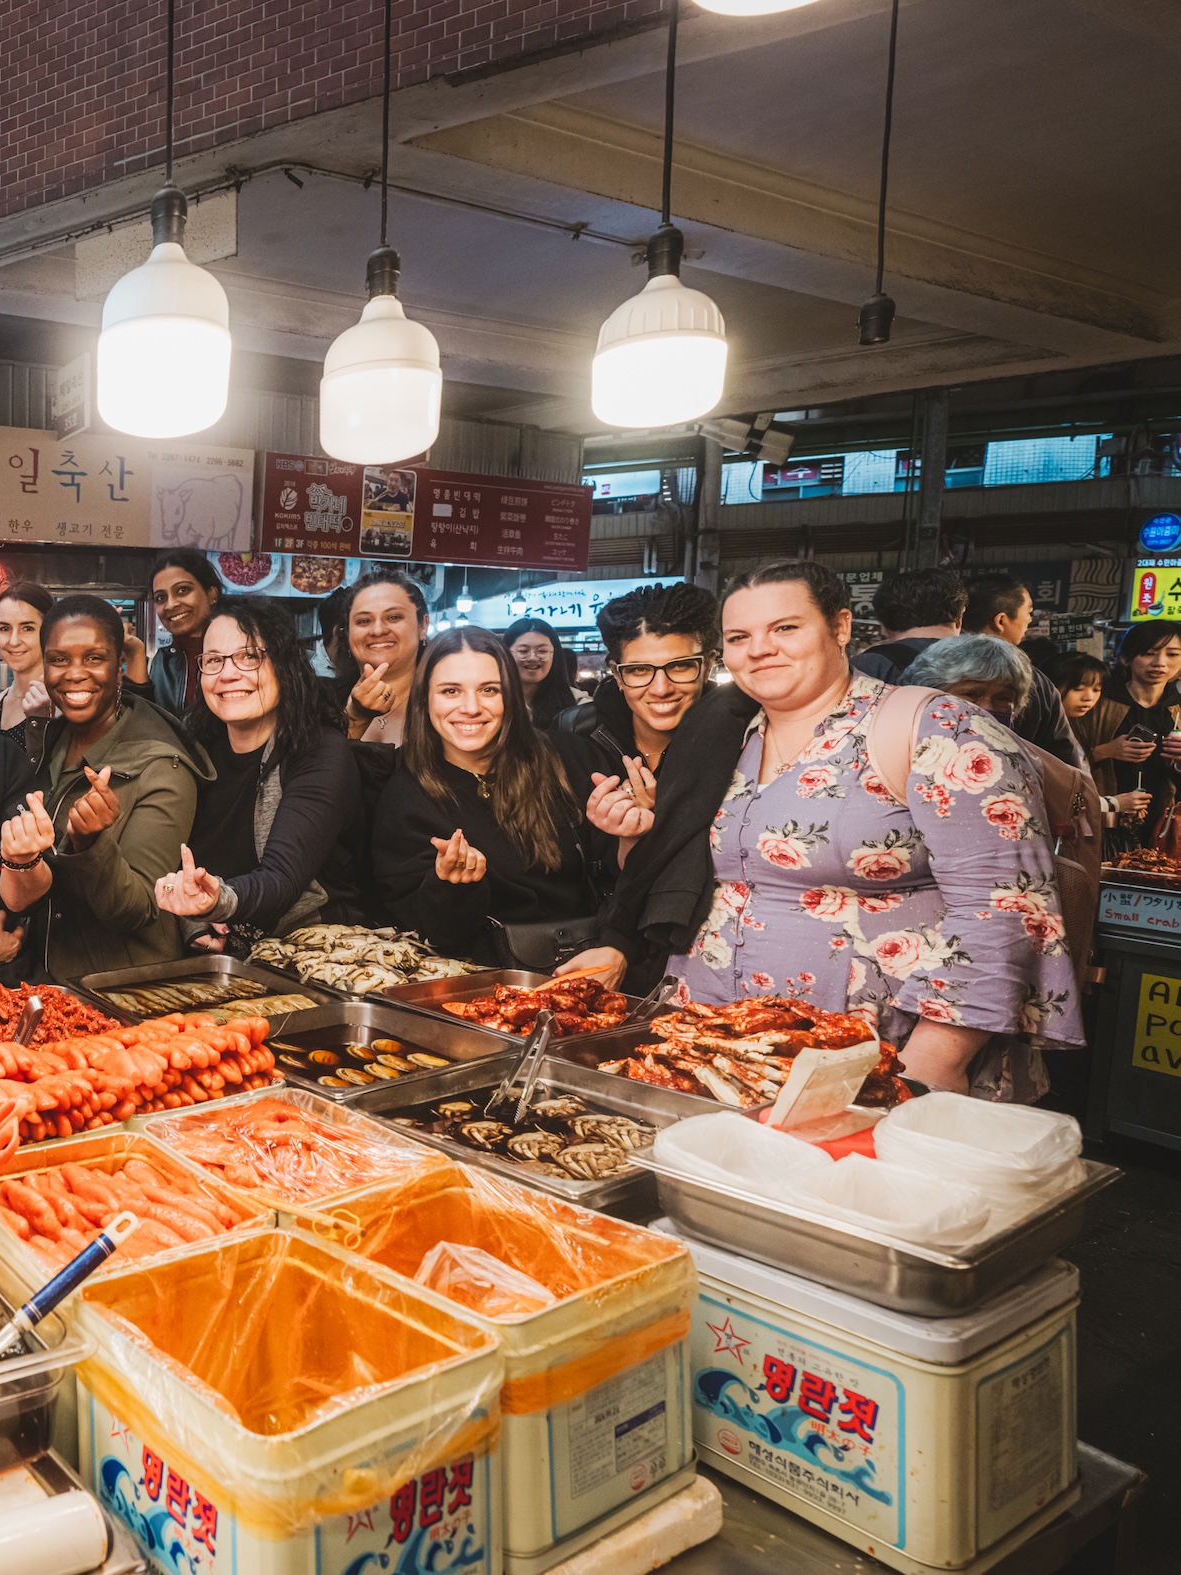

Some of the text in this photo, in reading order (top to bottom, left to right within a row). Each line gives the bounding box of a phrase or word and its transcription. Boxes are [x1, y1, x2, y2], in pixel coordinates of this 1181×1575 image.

[8, 518, 34, 533] 한우
[55, 521, 94, 537] 생고기
[101, 524, 125, 540] 전문
[1105, 908, 1140, 921] Small
[763, 1354, 879, 1444] 명란젓
[142, 1444, 218, 1557] 명란젓
[390, 1452, 475, 1544] 명란젓
